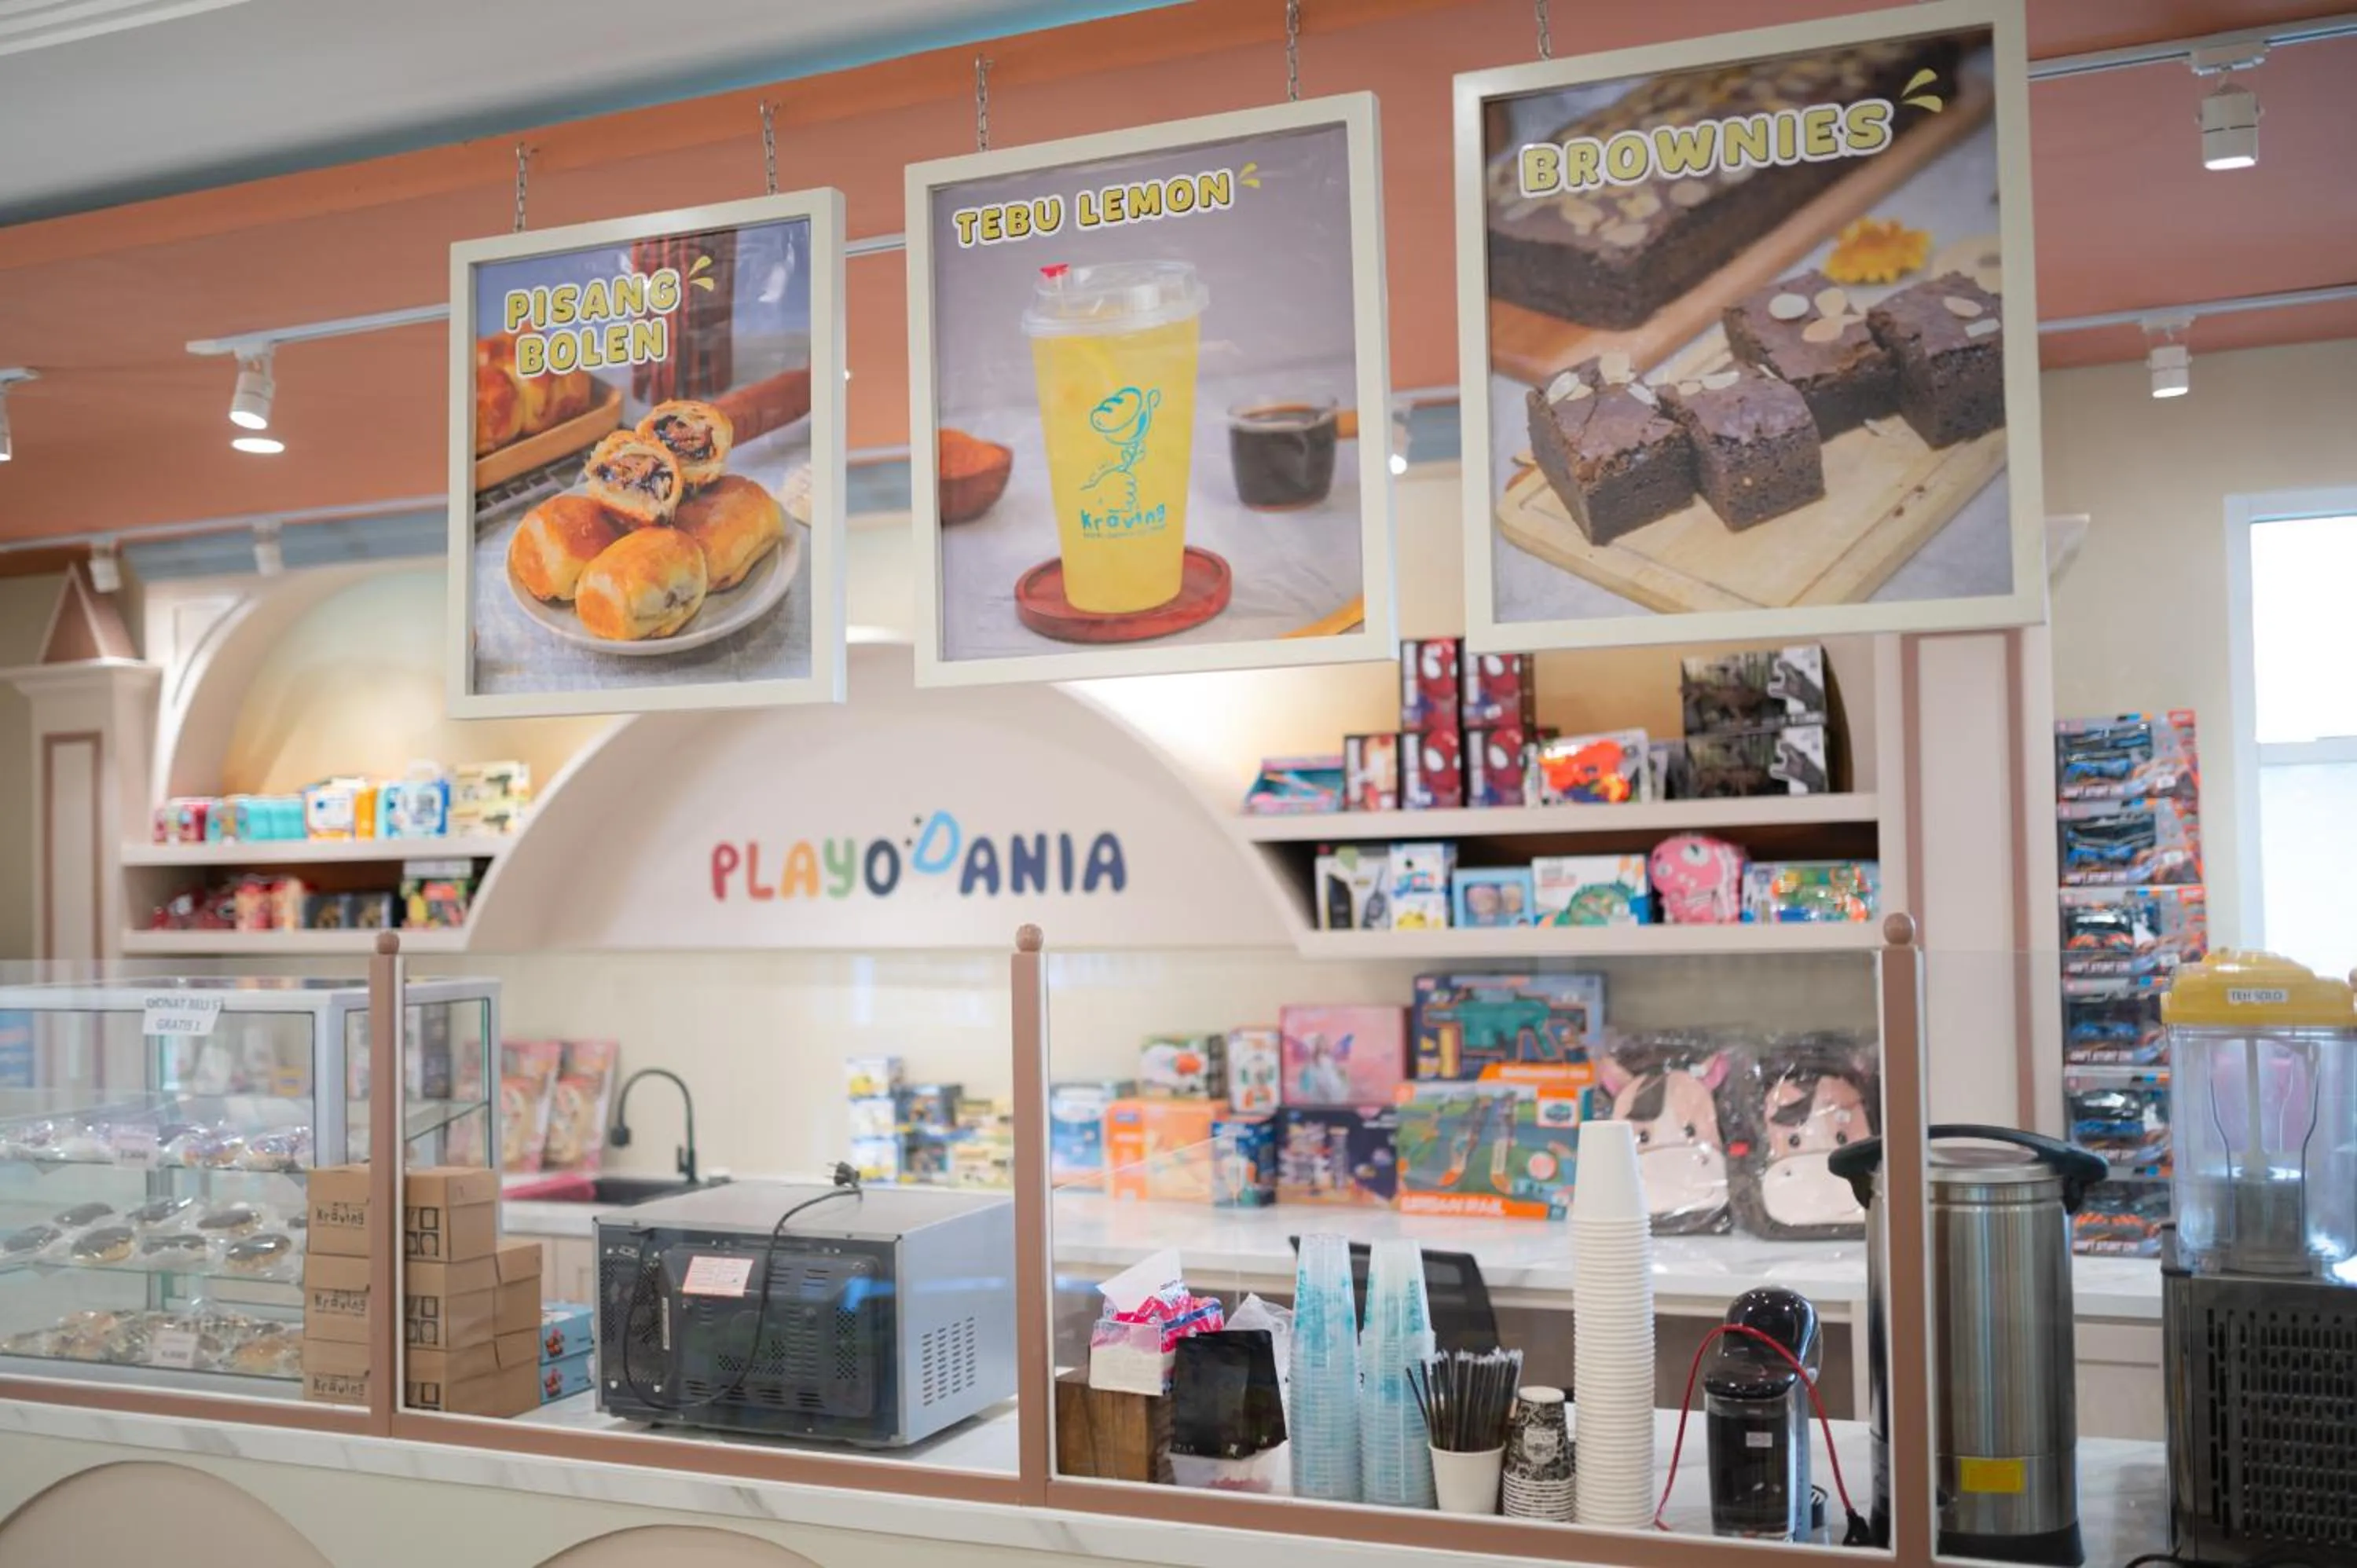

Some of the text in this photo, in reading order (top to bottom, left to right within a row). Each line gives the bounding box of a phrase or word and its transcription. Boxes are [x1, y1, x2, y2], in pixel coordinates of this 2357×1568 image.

[1519, 97, 1895, 198] BROWNIES
[953, 168, 1234, 247] TEBU LEMON
[506, 269, 680, 331] PISANG
[516, 318, 669, 378] BOLEN
[2232, 992, 2251, 1001] TEH
